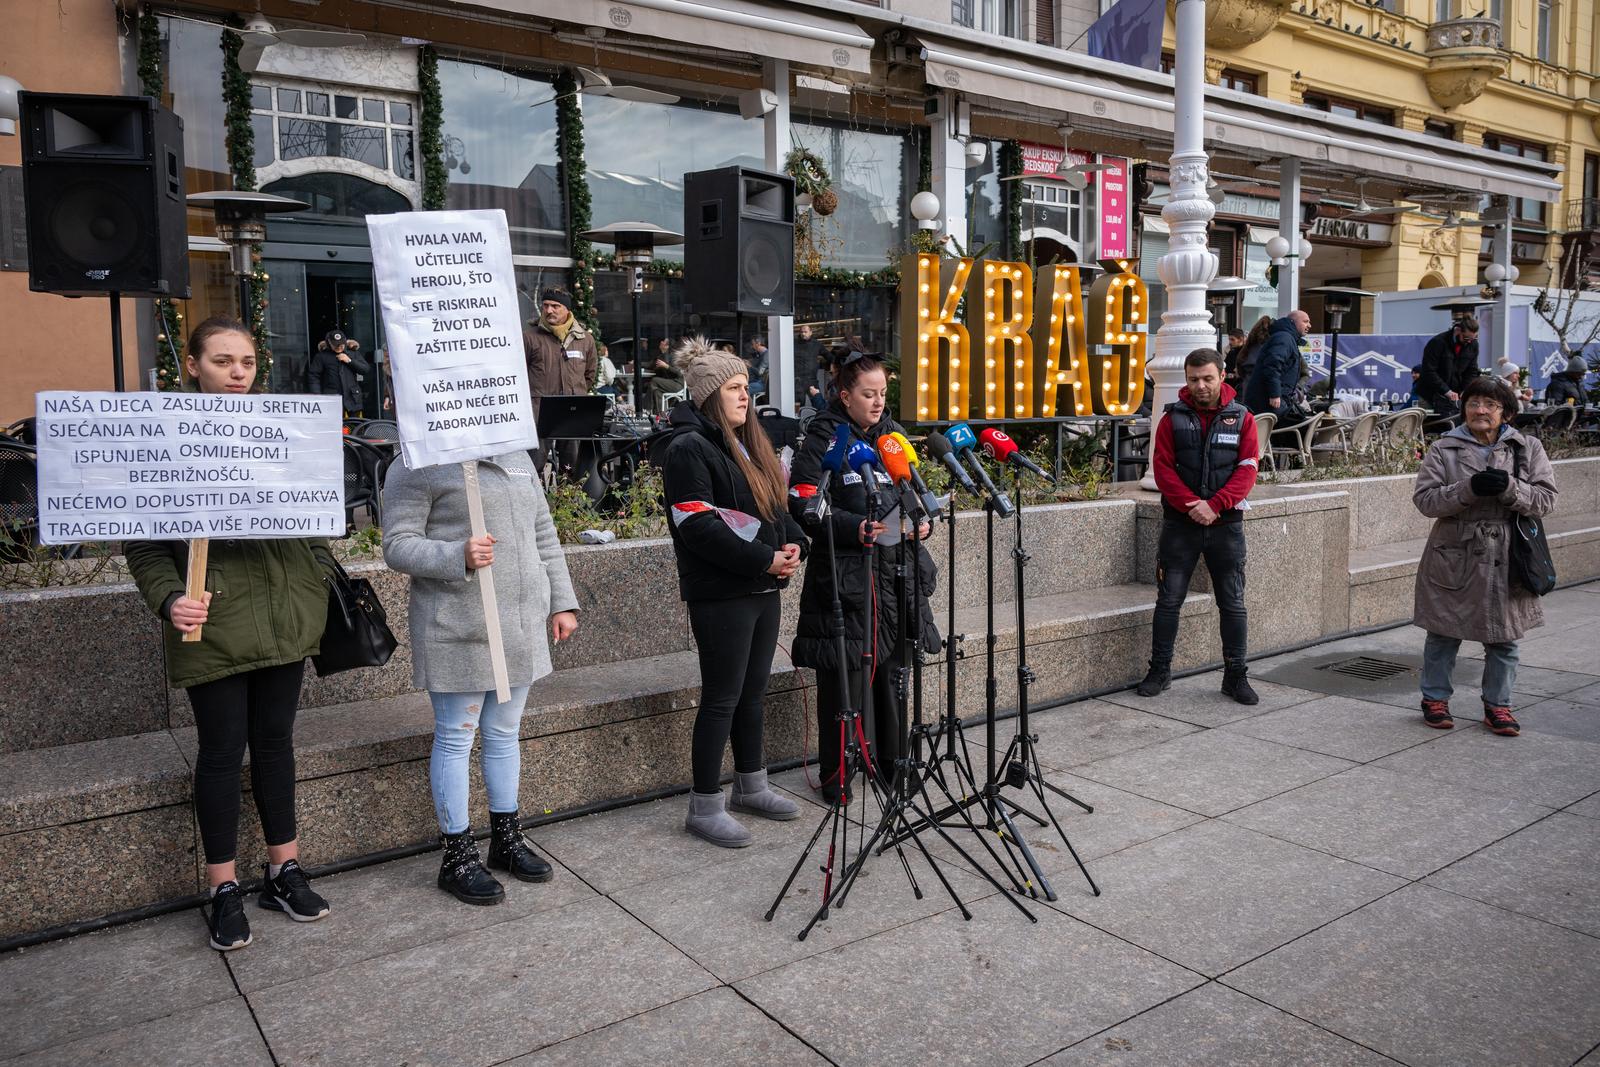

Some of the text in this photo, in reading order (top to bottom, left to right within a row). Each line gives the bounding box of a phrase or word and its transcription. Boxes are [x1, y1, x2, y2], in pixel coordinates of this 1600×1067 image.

[1020, 146, 1041, 159] AKUP
[1024, 160, 1054, 173] REDSKOG
[1041, 211, 1047, 220] 5
[406, 232, 487, 246] HVALA VAM,
[416, 253, 483, 266] UČITELJICE
[411, 271, 492, 289] HEROJU, ŠTO
[413, 297, 497, 312] STE RISKIRALI
[432, 318, 491, 332] ŽIVOT DA
[416, 337, 511, 354] ZAŠTITE DJECU.
[902, 253, 1147, 421] KRAŠ
[423, 376, 517, 394] VAŠA HRABROST
[45, 396, 322, 414] NAŠA DJECA ZASLUŽUJU SRETNA
[426, 394, 519, 413] NIKAD NEĆE BITI
[50, 420, 289, 442] SJEĆANJA NA ĐAČKO DOBA,
[428, 413, 520, 432] ZABORAVLJENA.
[952, 427, 972, 443] Z1
[75, 444, 288, 463] ISPUNJENA OSMIJEHOM I
[130, 466, 254, 482] BEZBRIŽNOŠĆU.
[48, 490, 339, 510] NEĆEMO DOPUSTITI DA SE OVAKVA
[48, 522, 144, 536] TRAGEDIJA
[153, 520, 204, 534] IKADA
[209, 516, 242, 532] VIŠE
[251, 518, 311, 531] PONOVI
